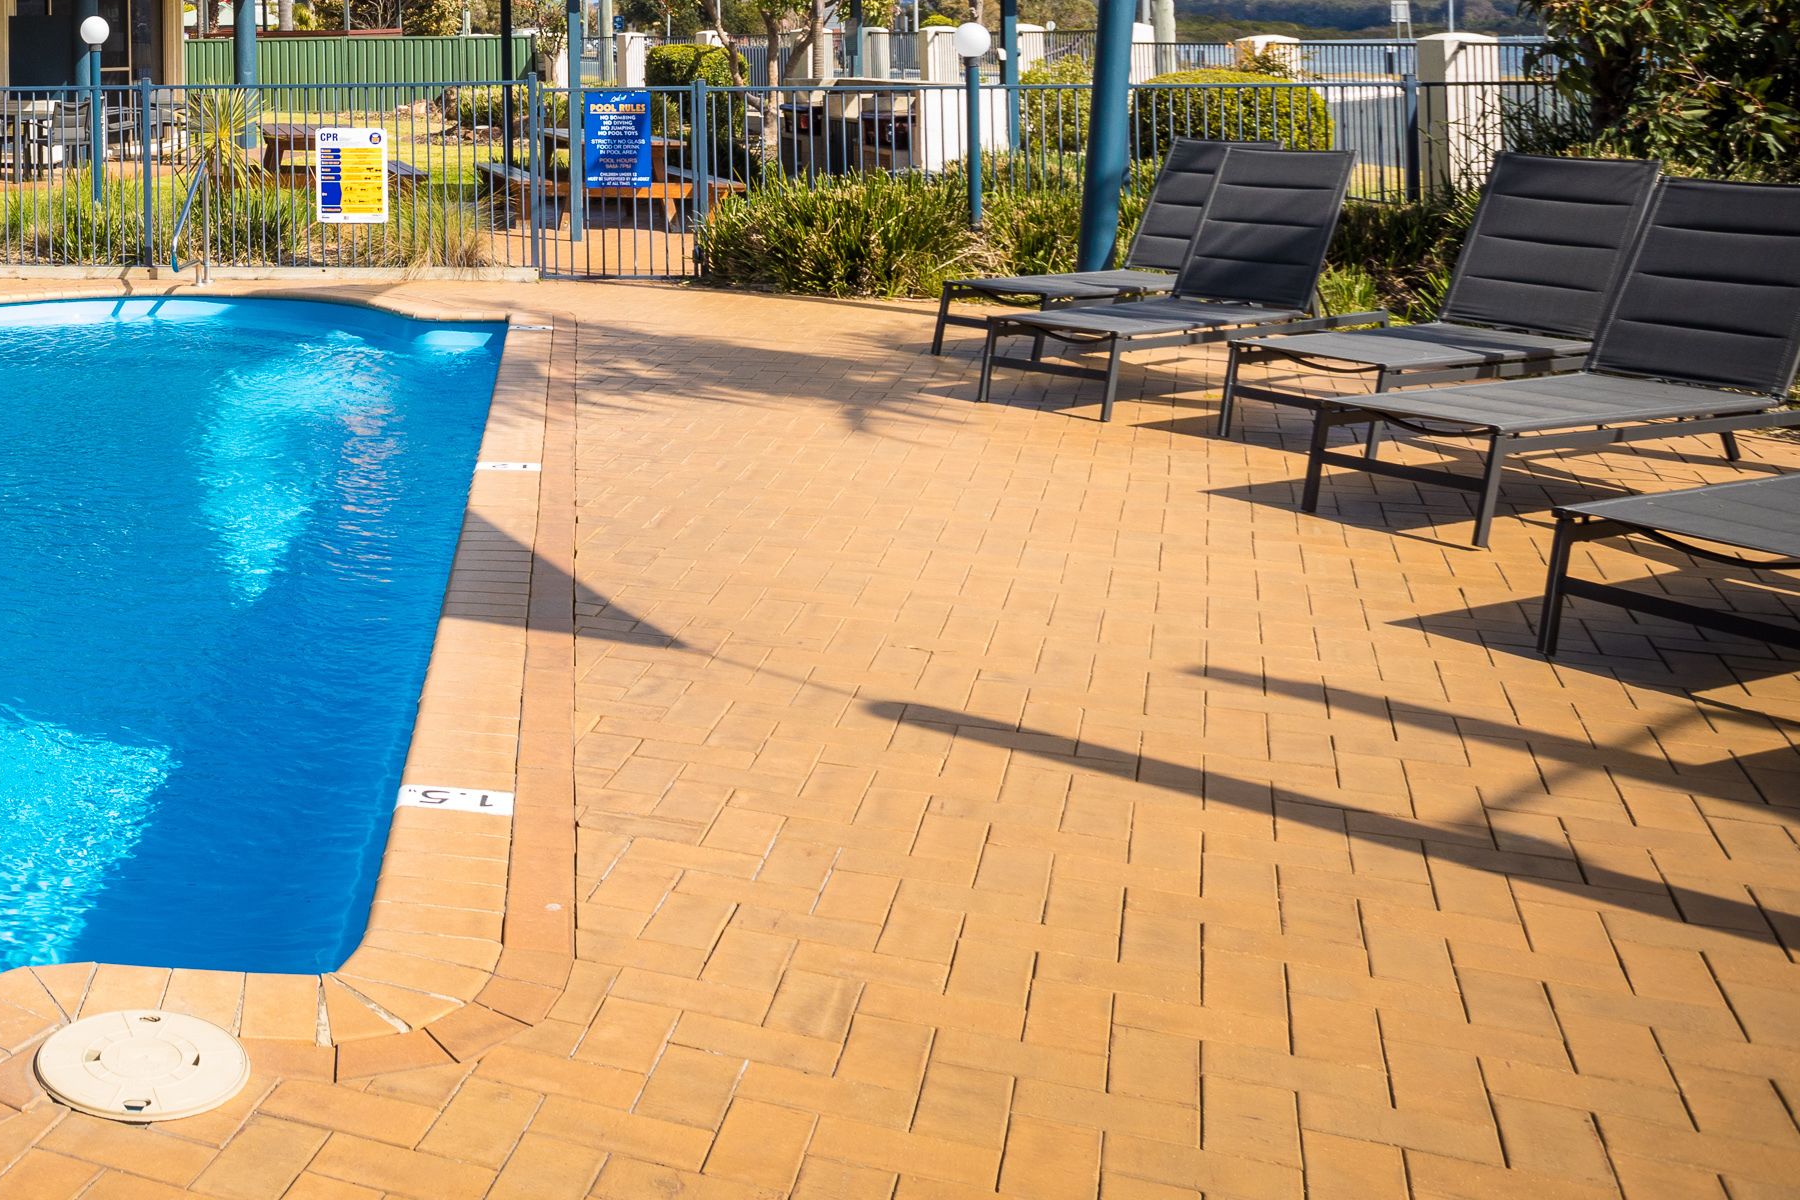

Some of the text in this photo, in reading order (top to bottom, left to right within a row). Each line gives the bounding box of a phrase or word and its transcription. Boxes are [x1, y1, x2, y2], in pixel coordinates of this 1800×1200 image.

[590, 104, 645, 112] POOL RULES
[320, 133, 338, 141] CPR
[419, 790, 493, 806] 1.5
